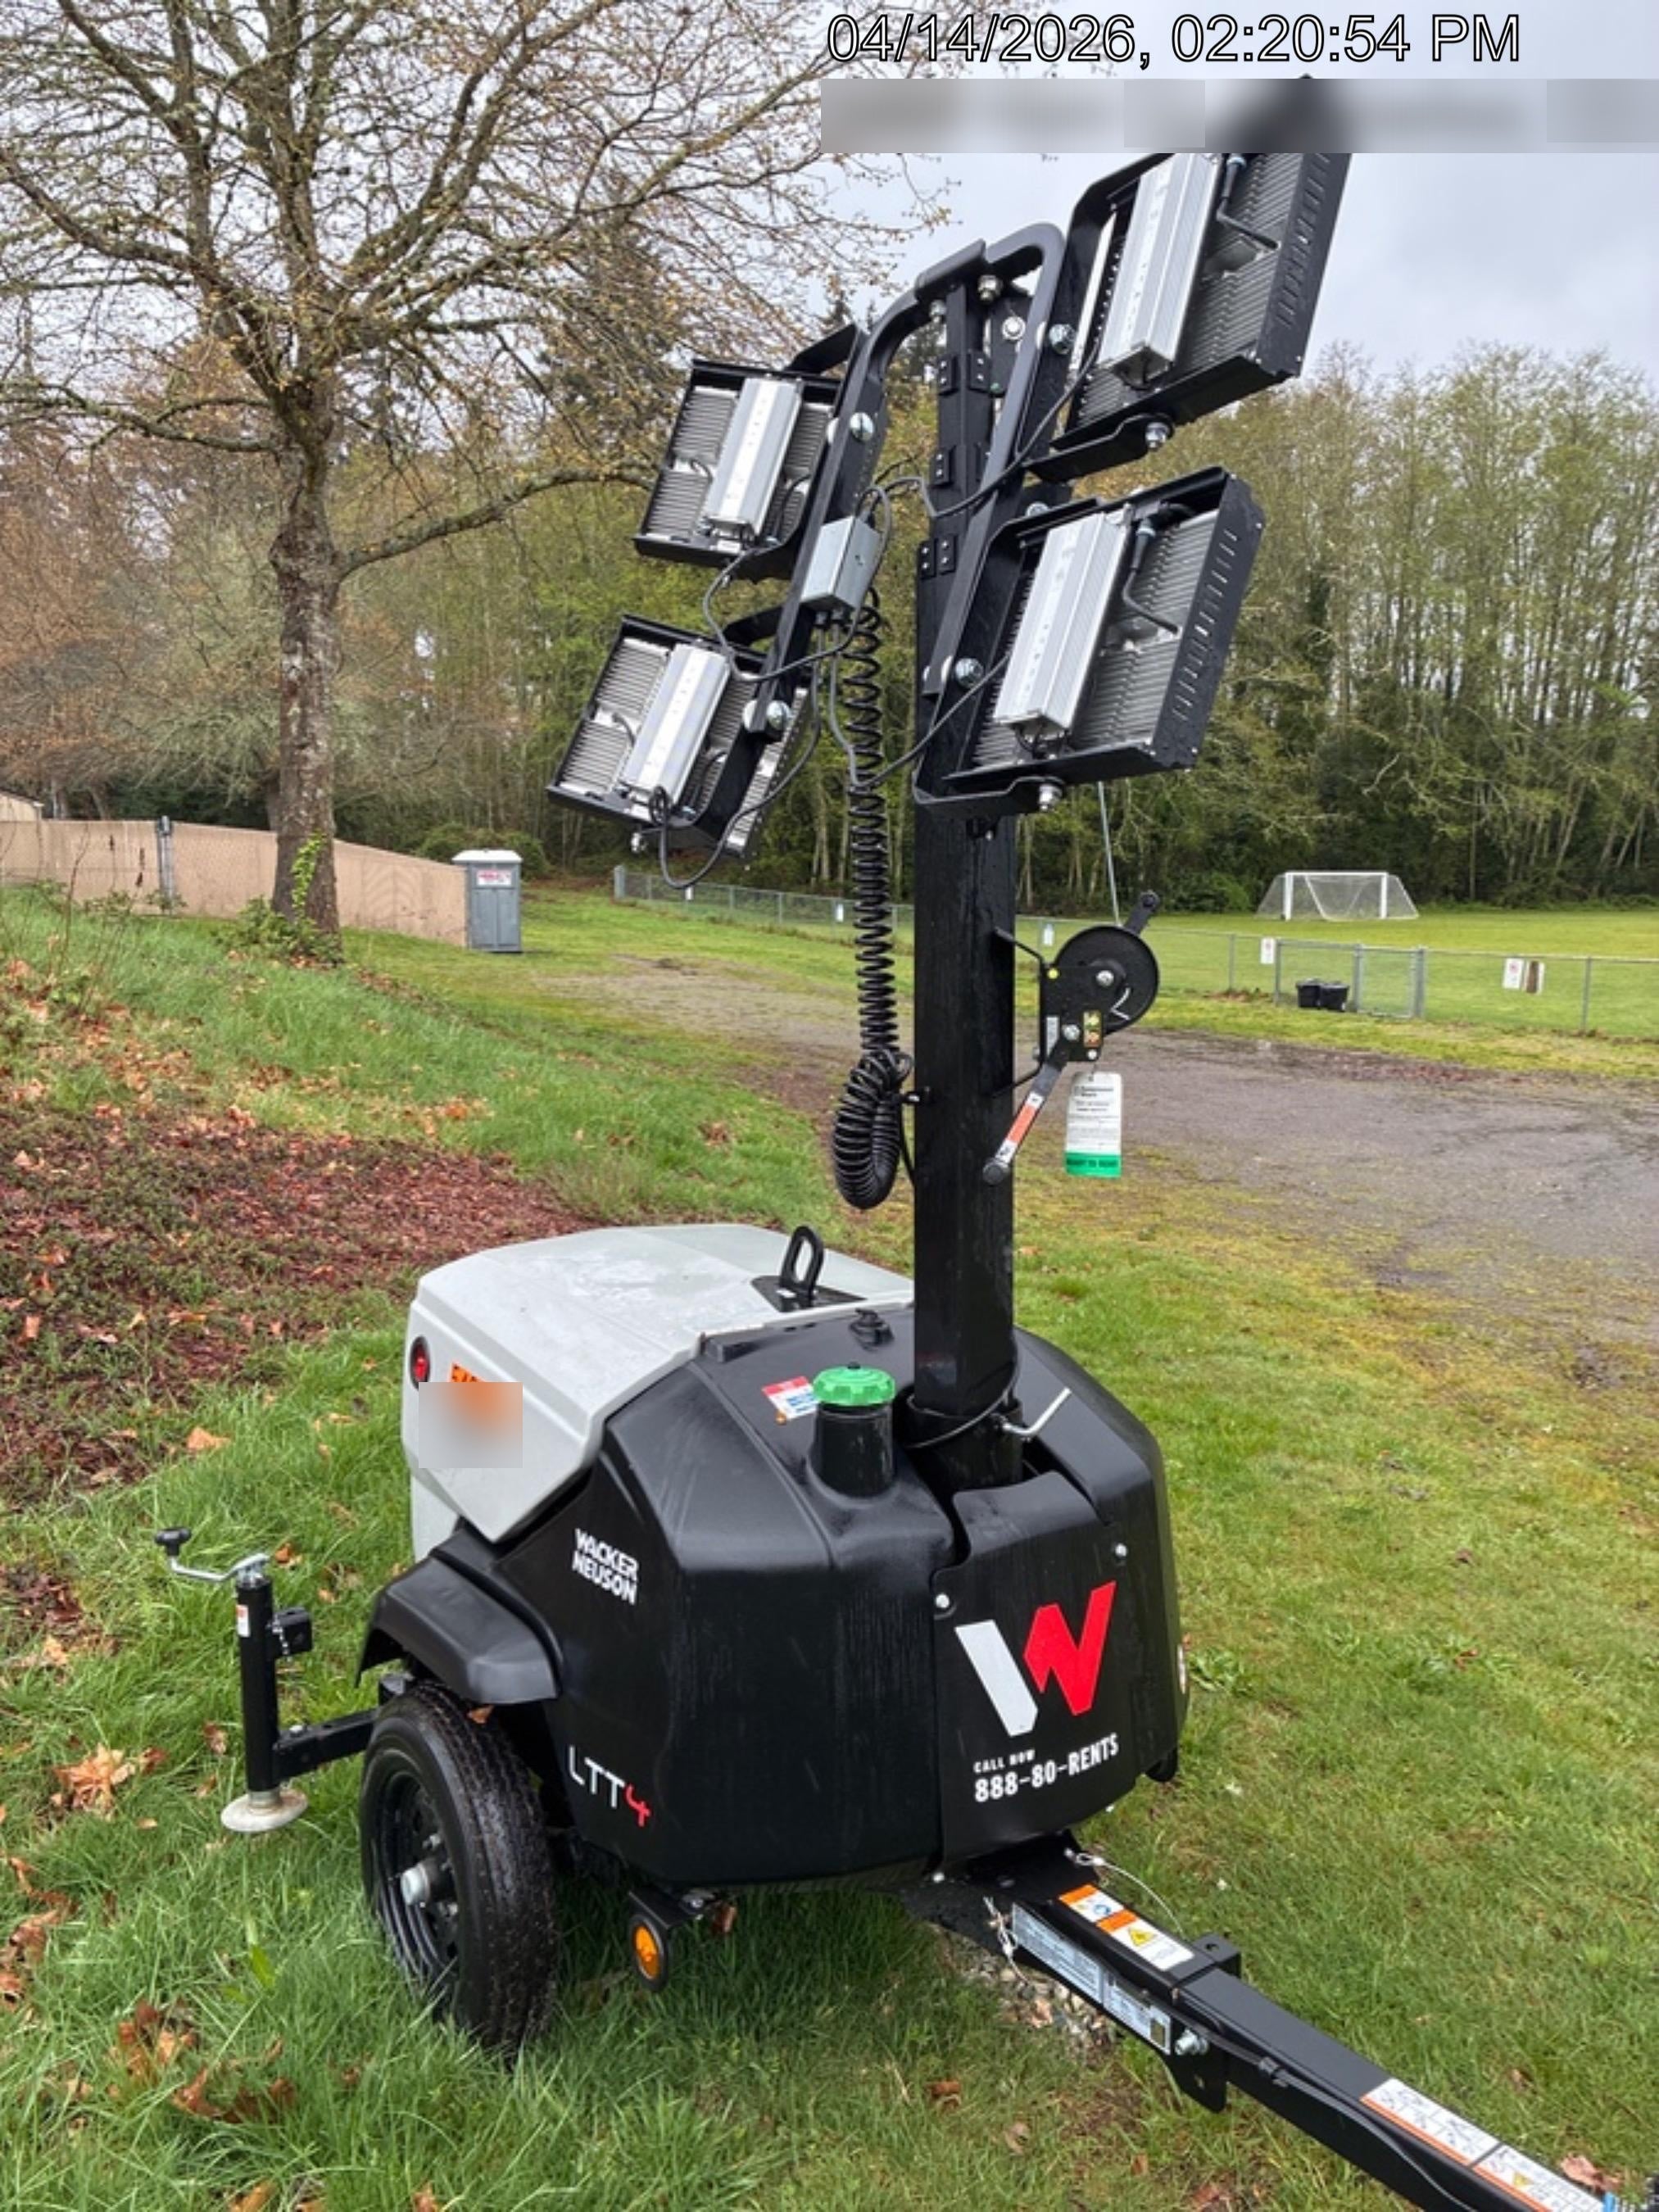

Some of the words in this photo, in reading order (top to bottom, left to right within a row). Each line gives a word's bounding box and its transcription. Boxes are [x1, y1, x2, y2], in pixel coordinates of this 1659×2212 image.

[572, 1550, 637, 1605] NEUSON
[575, 1527, 637, 1581] WACKER
[569, 1744, 650, 1827] LTT4
[973, 1756, 1005, 1774] CALL
[1009, 1748, 1036, 1766] NOW
[974, 1731, 1119, 1802] 888-80-RENTS
